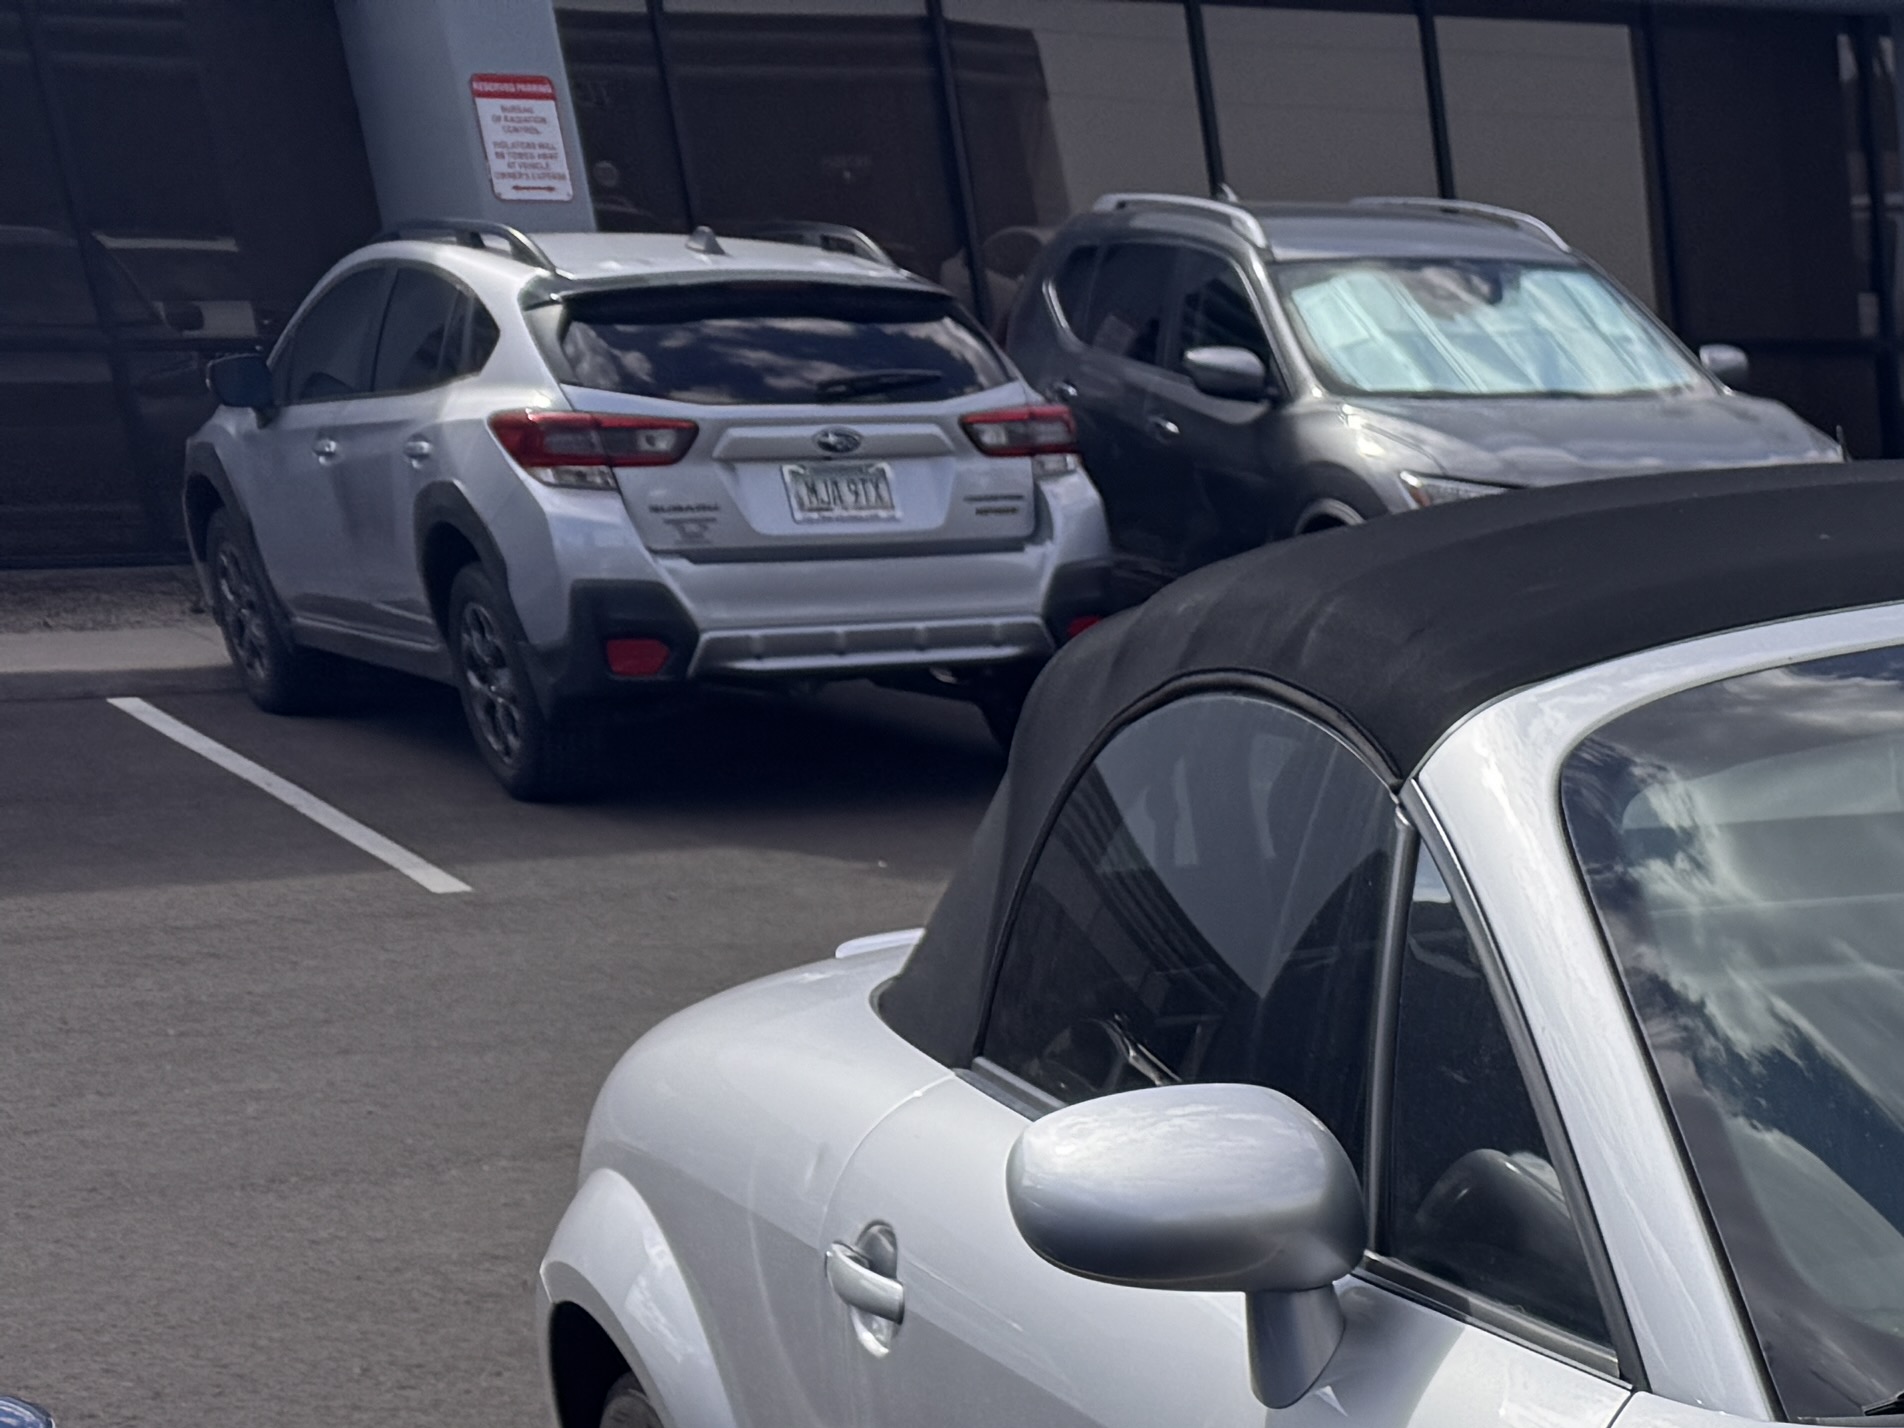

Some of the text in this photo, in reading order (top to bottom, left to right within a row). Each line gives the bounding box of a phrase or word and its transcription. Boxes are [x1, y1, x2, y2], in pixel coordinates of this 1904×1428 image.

[472, 81, 552, 93] RESERVED PARKING
[648, 502, 720, 513] SUBARU
